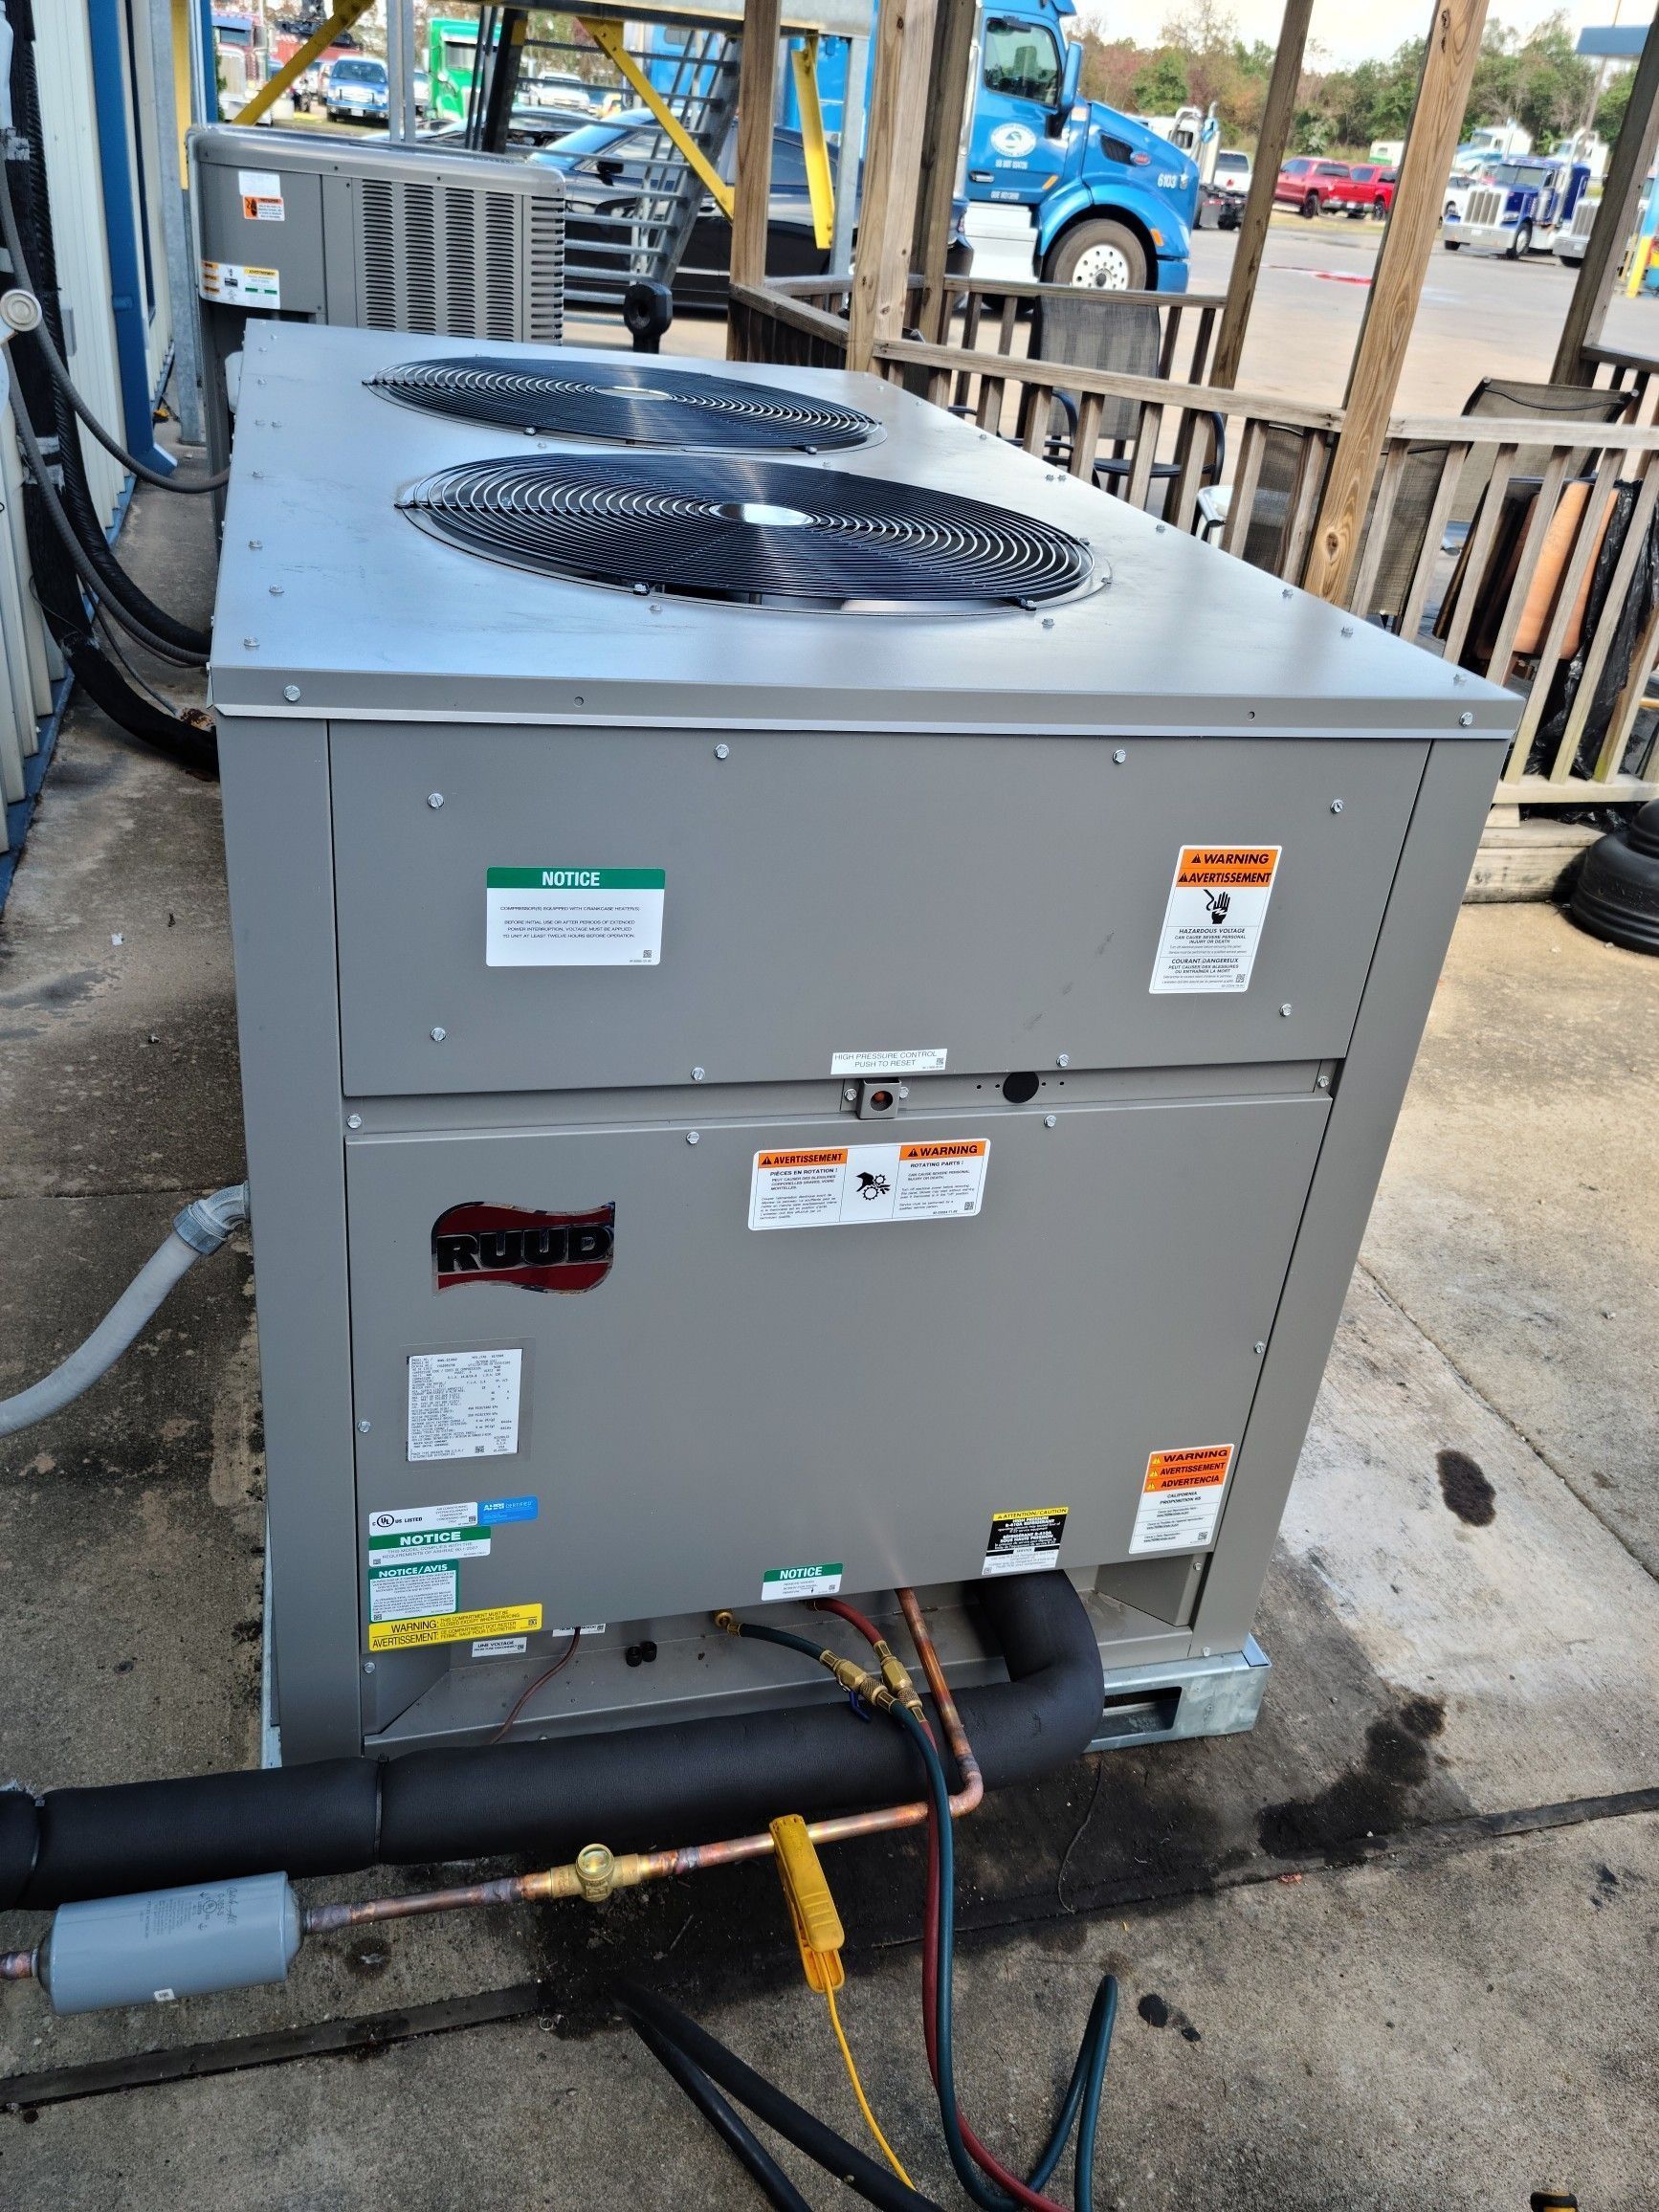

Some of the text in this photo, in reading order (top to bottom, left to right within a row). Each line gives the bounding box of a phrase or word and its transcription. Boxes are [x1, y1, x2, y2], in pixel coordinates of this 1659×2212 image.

[1157, 173, 1177, 189] 6103
[1204, 854, 1269, 864] WARNING
[542, 871, 600, 886] NOTICE
[1188, 873, 1272, 883] AVERTISSEMENT
[920, 1145, 977, 1156] WARNING
[774, 1153, 842, 1164] AVERTISSEMENT
[436, 1224, 611, 1272] RUUD
[1164, 1450, 1228, 1462] WARNING
[1160, 1462, 1225, 1475] AVERTISSEMENT
[1161, 1475, 1219, 1488] ADVERTENCIA
[1003, 1508, 1067, 1518] ATTENTION/CAUTION
[400, 1531, 461, 1546] NOTICE
[378, 1564, 448, 1578] NOTICE/AVIS
[779, 1566, 823, 1580] NOTICE
[452, 1613, 487, 1621] COMPARTMENT
[391, 1619, 439, 1634] WARNING:
[373, 1631, 439, 1649] AVERTISSEMENT:
